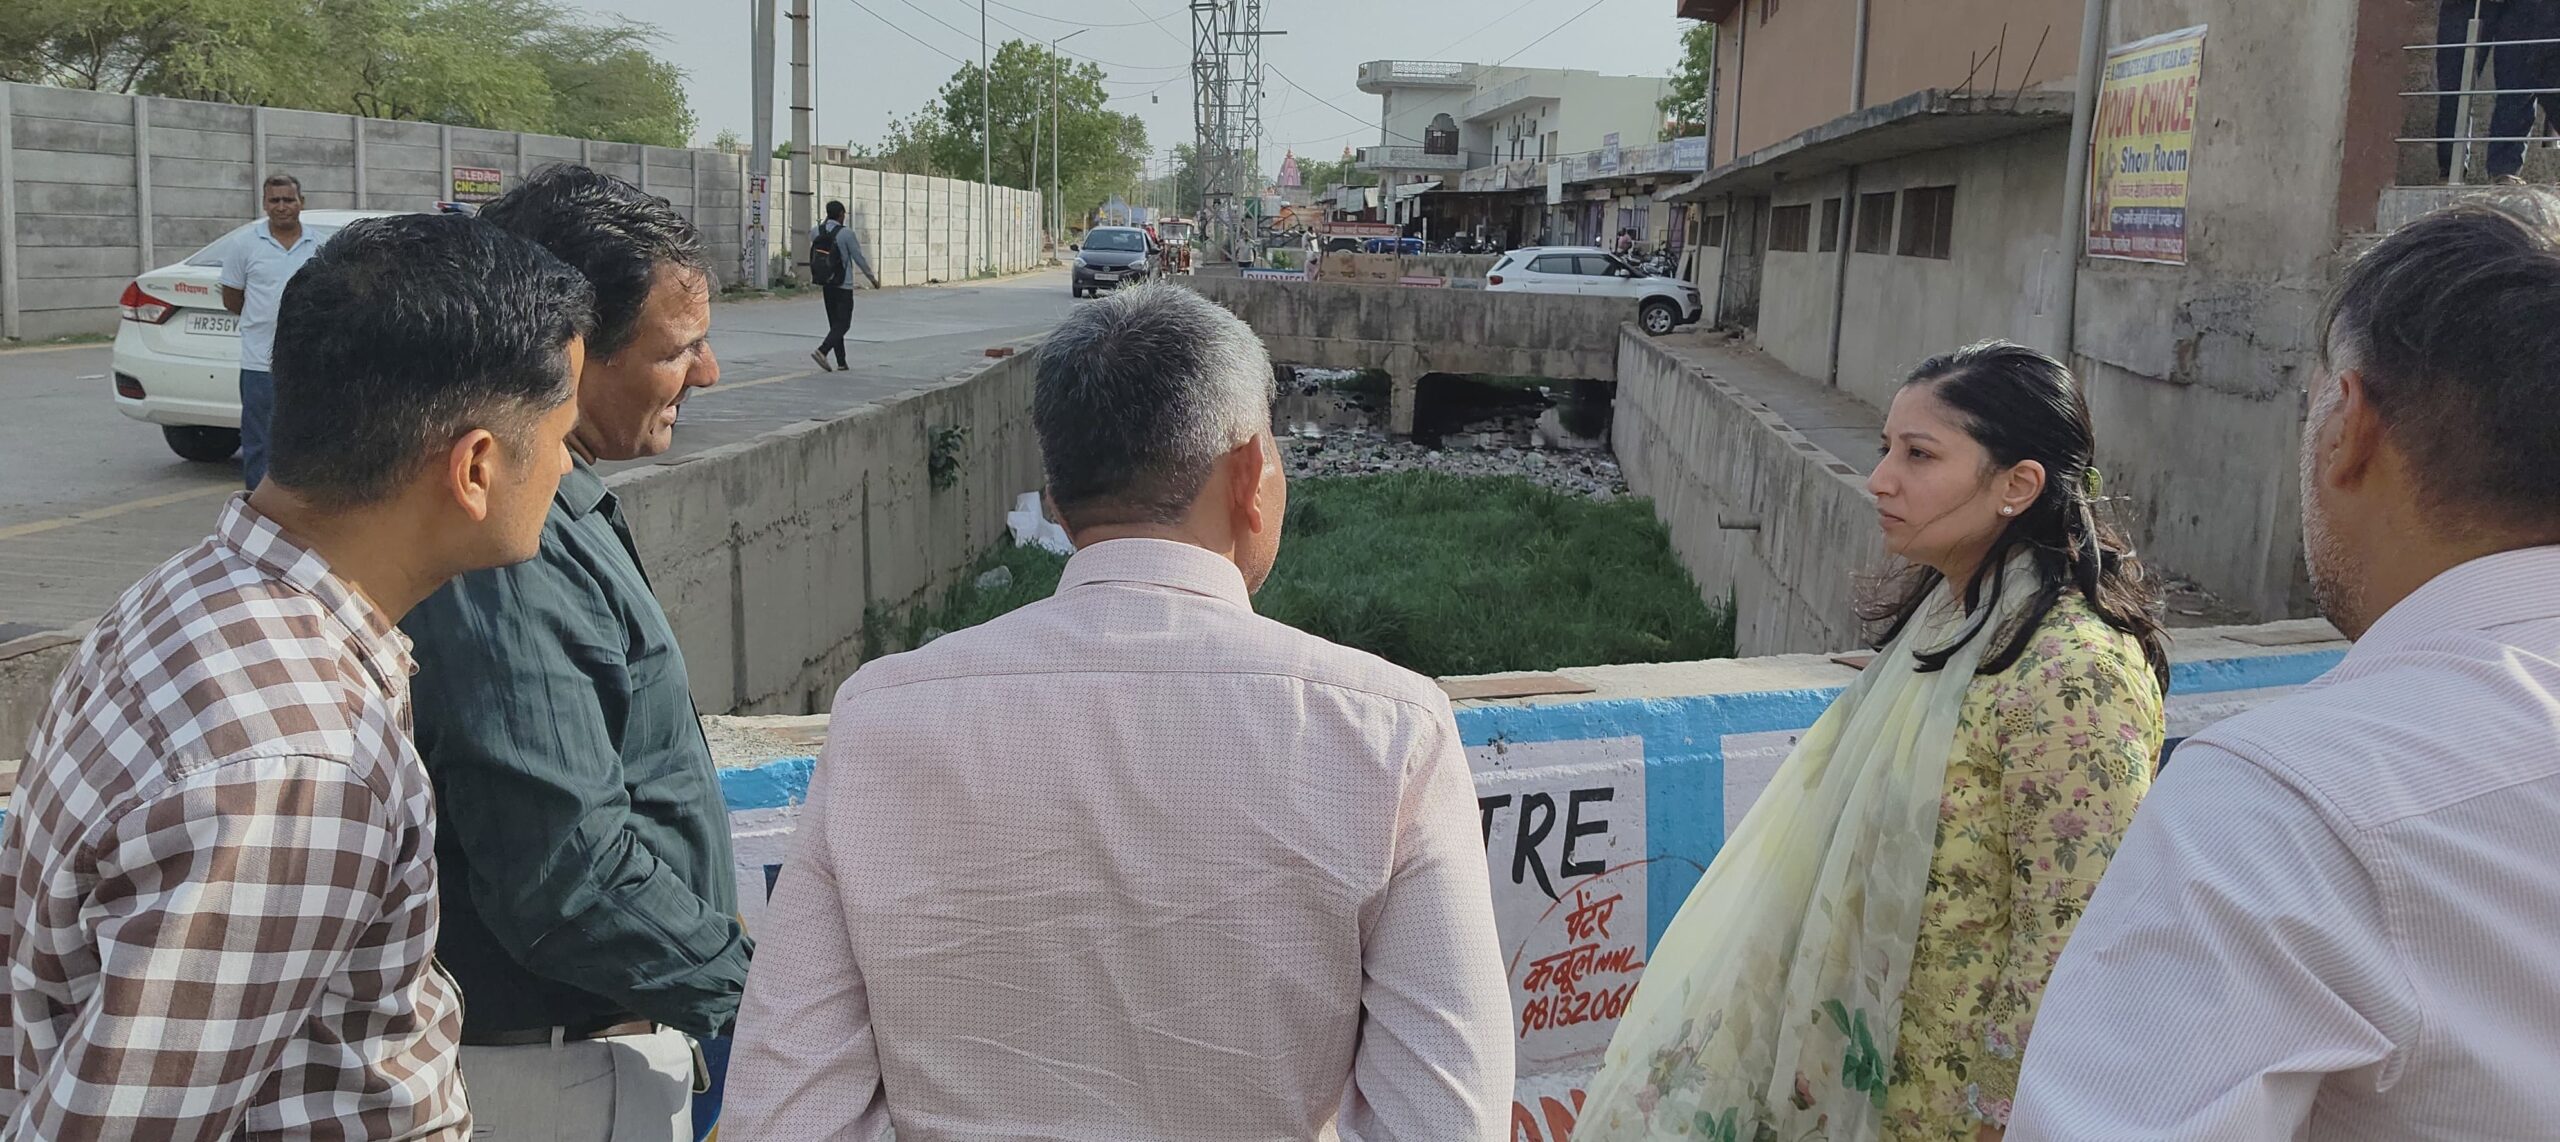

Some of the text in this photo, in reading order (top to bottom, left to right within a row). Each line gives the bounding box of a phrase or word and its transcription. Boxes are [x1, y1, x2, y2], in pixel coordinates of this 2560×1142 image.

[2099, 75, 2196, 138] YOUR CHOICE
[2120, 143, 2187, 173] Show Room
[455, 180, 475, 192] CNC
